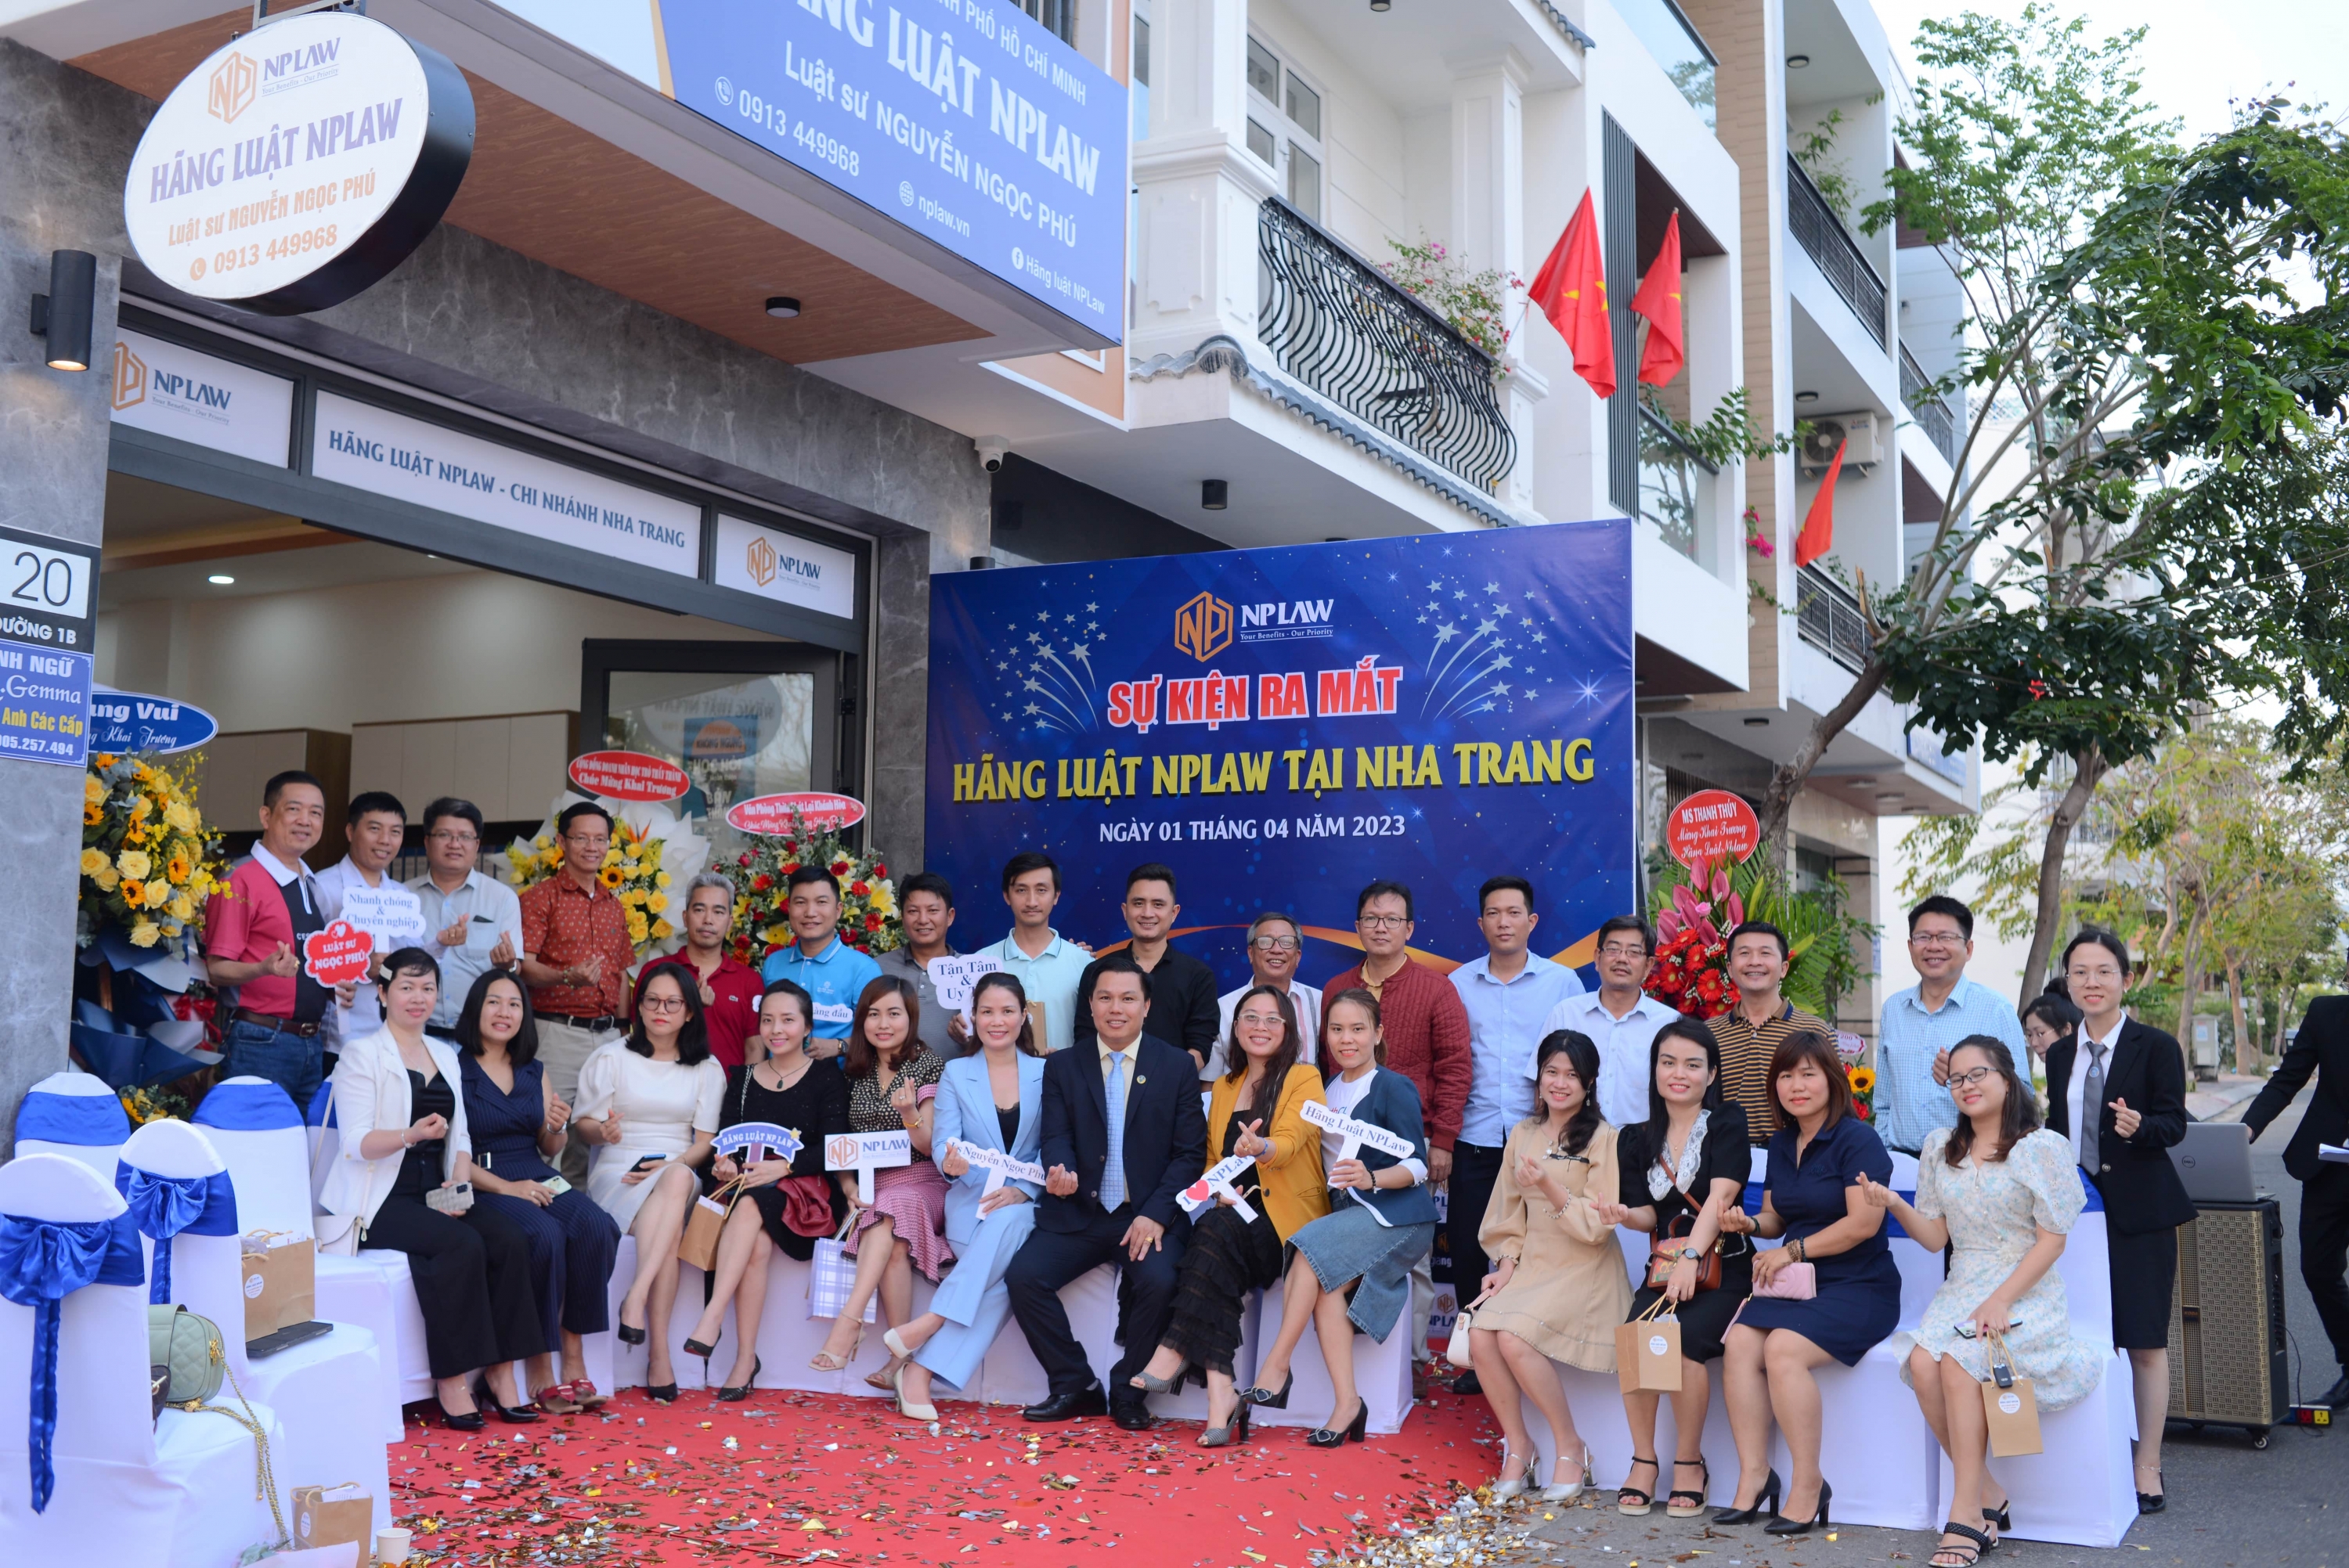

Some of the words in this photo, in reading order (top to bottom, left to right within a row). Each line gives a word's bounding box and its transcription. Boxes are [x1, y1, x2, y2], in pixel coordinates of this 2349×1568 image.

[965, 0, 995, 40] PHỐ
[1001, 25, 1020, 58] HỒ
[1024, 43, 1048, 78] CHÍ
[1052, 63, 1087, 106] MINH
[276, 80, 299, 91] Benefits
[304, 74, 316, 82] Our
[316, 68, 339, 78] Priority
[797, 0, 875, 47] NG
[887, 5, 981, 118] LUẬT
[989, 75, 1101, 197] NPLAW
[739, 89, 786, 136] 0913
[793, 121, 860, 177] 449968
[785, 40, 835, 103] Luật
[841, 83, 869, 121] sư
[876, 99, 969, 183] NGUYỄN
[975, 161, 1033, 221] NGỌC
[1038, 202, 1077, 247] PHÚ
[150, 149, 225, 204] HÃNG
[233, 123, 300, 181] LUẬT
[305, 97, 403, 161] NPLAW
[168, 218, 200, 247] Luật
[204, 212, 225, 237] sư
[229, 189, 288, 231] NGUYỄN
[294, 182, 337, 214] NGỌC
[343, 168, 376, 202] PHÚ
[918, 195, 970, 238] nplaw.vn
[214, 243, 260, 274] 0913
[266, 224, 337, 261] 449968
[1027, 254, 1052, 289] Hãng
[1054, 271, 1071, 297] luật
[1073, 284, 1105, 315] NPLaw
[153, 369, 232, 410] NPLAW
[329, 429, 384, 463] HÃNG
[391, 447, 434, 477] LUẬT
[438, 463, 496, 494] NPLAW
[510, 482, 538, 506] CHI
[543, 491, 598, 524] NHÁNH
[603, 509, 634, 534] NHA
[638, 519, 686, 549] TRANG
[11, 551, 72, 607] 20
[1240, 599, 1334, 627] NPLAW
[57, 628, 77, 645] 1B
[1257, 631, 1285, 640] Benefits
[1307, 628, 1333, 636] Priority
[30, 655, 74, 678] NGỮ
[1108, 673, 1164, 734] SỰ
[1166, 669, 1250, 731] KIỆN
[1257, 672, 1310, 720] RA
[1317, 654, 1403, 717] MẮT
[2, 707, 27, 727] Anh
[30, 710, 55, 731] Các
[59, 714, 84, 737] Cấp
[136, 702, 180, 721] Vui
[0, 735, 74, 756] 05.257.494
[101, 725, 132, 742] Khai
[953, 753, 1047, 802] HÃNG
[1057, 748, 1142, 806] LUẬT
[1152, 751, 1274, 795] NPLAW
[1283, 748, 1344, 799] TẠI
[1355, 744, 1443, 788] NHA
[1452, 737, 1594, 784] TRANG
[1099, 817, 1153, 842] NGÀY
[1159, 821, 1182, 842] 01
[1189, 814, 1257, 840] THÁNG
[1264, 818, 1289, 838] 04
[1296, 813, 1345, 838] NĂM
[1352, 815, 1405, 837] 2023
[1681, 809, 1694, 824] MS
[1694, 805, 1717, 823] THANH
[348, 893, 381, 905] Nhanh
[384, 893, 413, 909] chóng
[377, 906, 385, 915] &
[346, 914, 384, 928] Chuyên
[386, 917, 419, 930] nghiệp
[314, 956, 344, 970] NGỌC
[345, 950, 366, 964] PHÚ
[323, 939, 344, 953] LUẬT
[345, 939, 357, 950] SƯ
[937, 963, 963, 978] Tận
[967, 961, 997, 973] Tâm
[961, 975, 972, 986] &
[947, 987, 965, 1001] Uy
[722, 1134, 744, 1146] HÃNG
[745, 1130, 765, 1143] LUẬT
[1305, 1105, 1335, 1127] Hãng
[1337, 1119, 1364, 1137] Luật
[1366, 1129, 1408, 1153] NPLaw
[964, 1145, 999, 1165] Nguyễn
[1001, 1159, 1026, 1175] Ngọc
[1182, 1195, 1191, 1206] I
